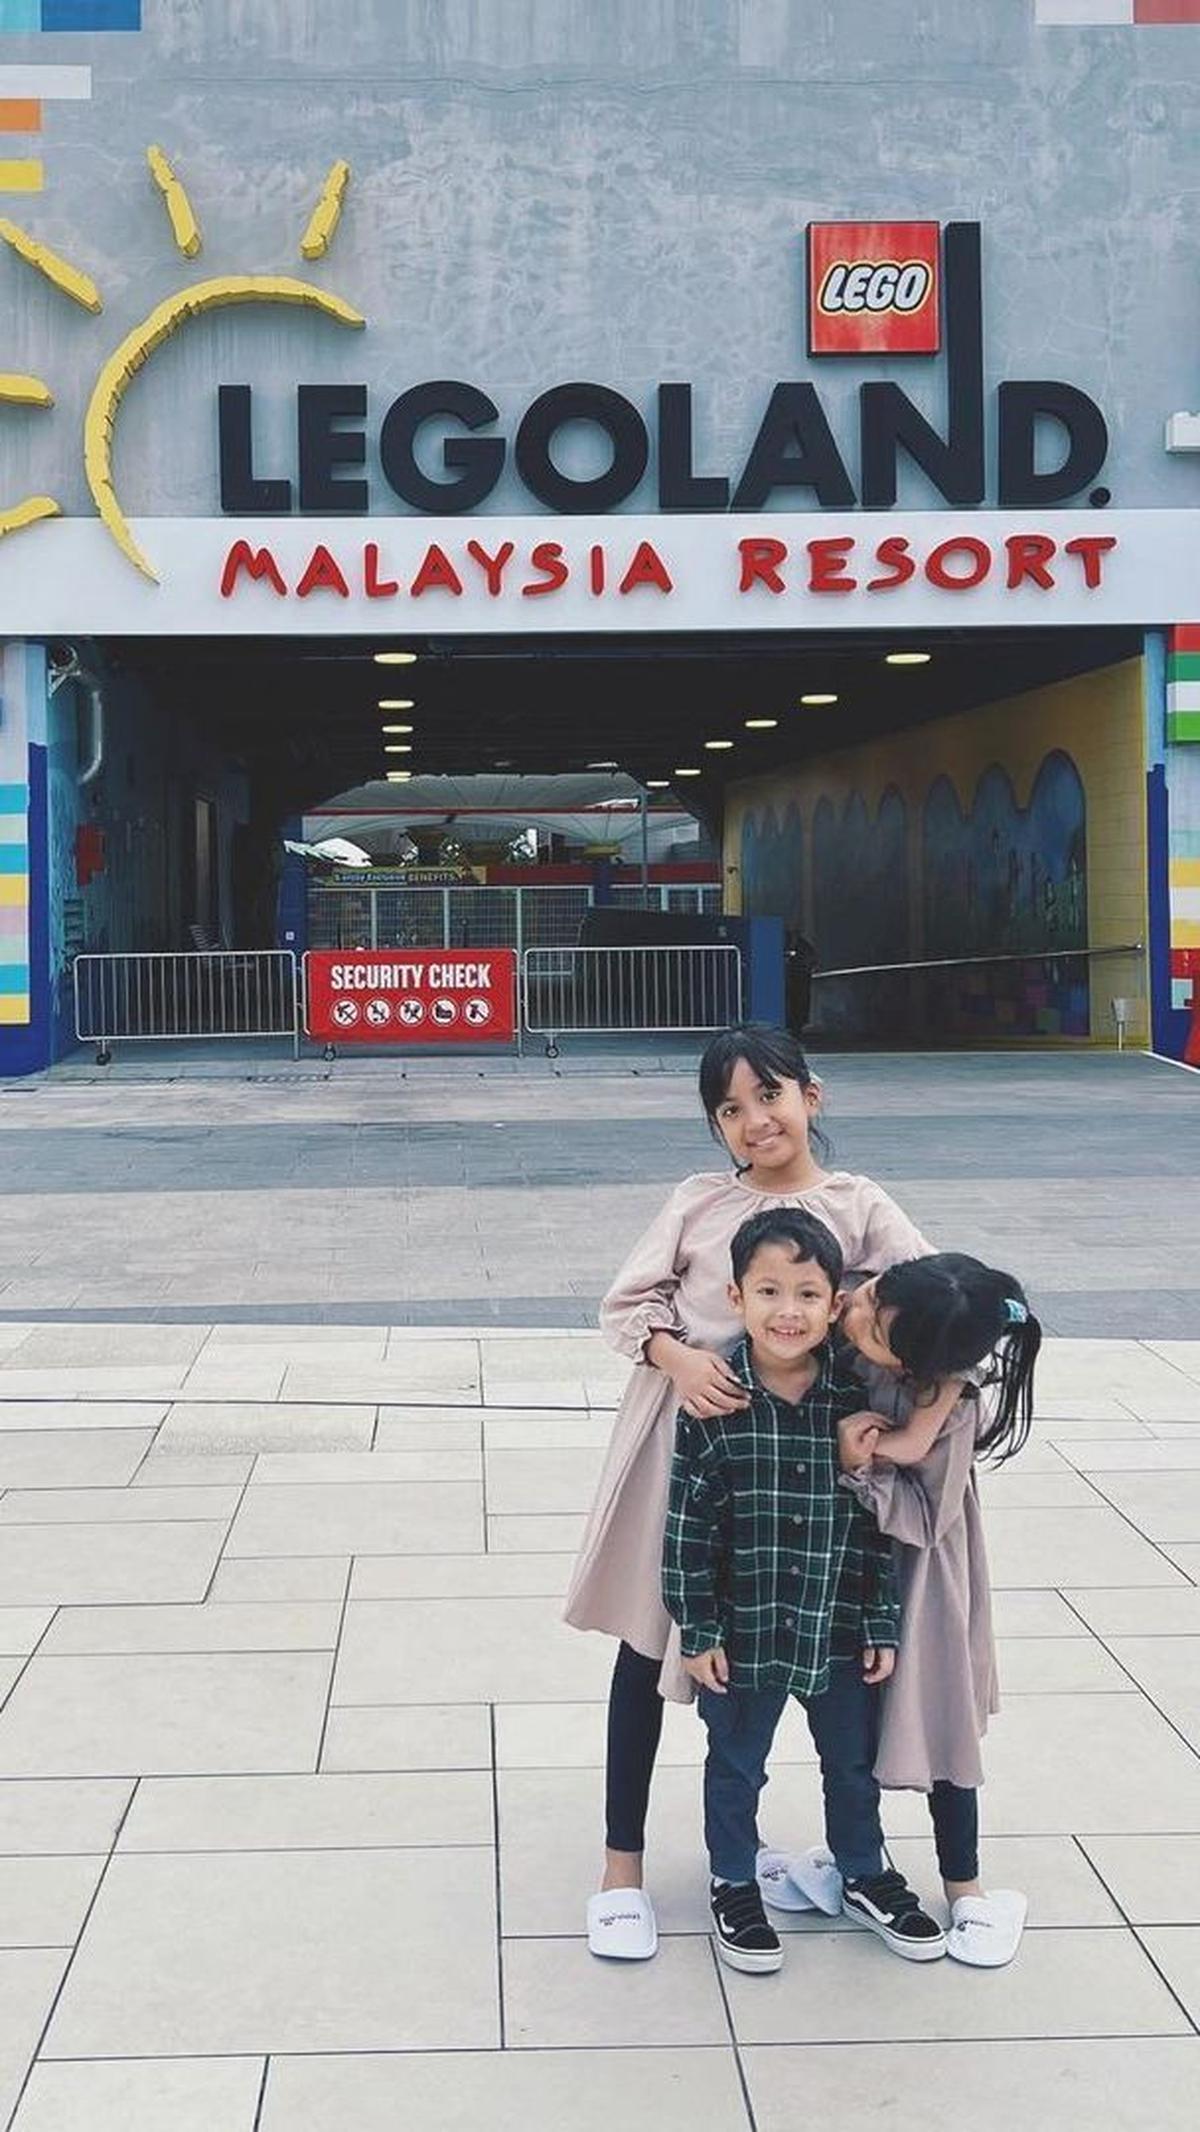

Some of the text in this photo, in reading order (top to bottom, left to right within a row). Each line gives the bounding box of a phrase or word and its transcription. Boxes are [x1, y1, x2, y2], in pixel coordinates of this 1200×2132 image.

[820, 263, 930, 312] LEGO
[220, 534, 1117, 597] MALAYSIA RESORT
[331, 963, 491, 989] SECURITY CHECK
